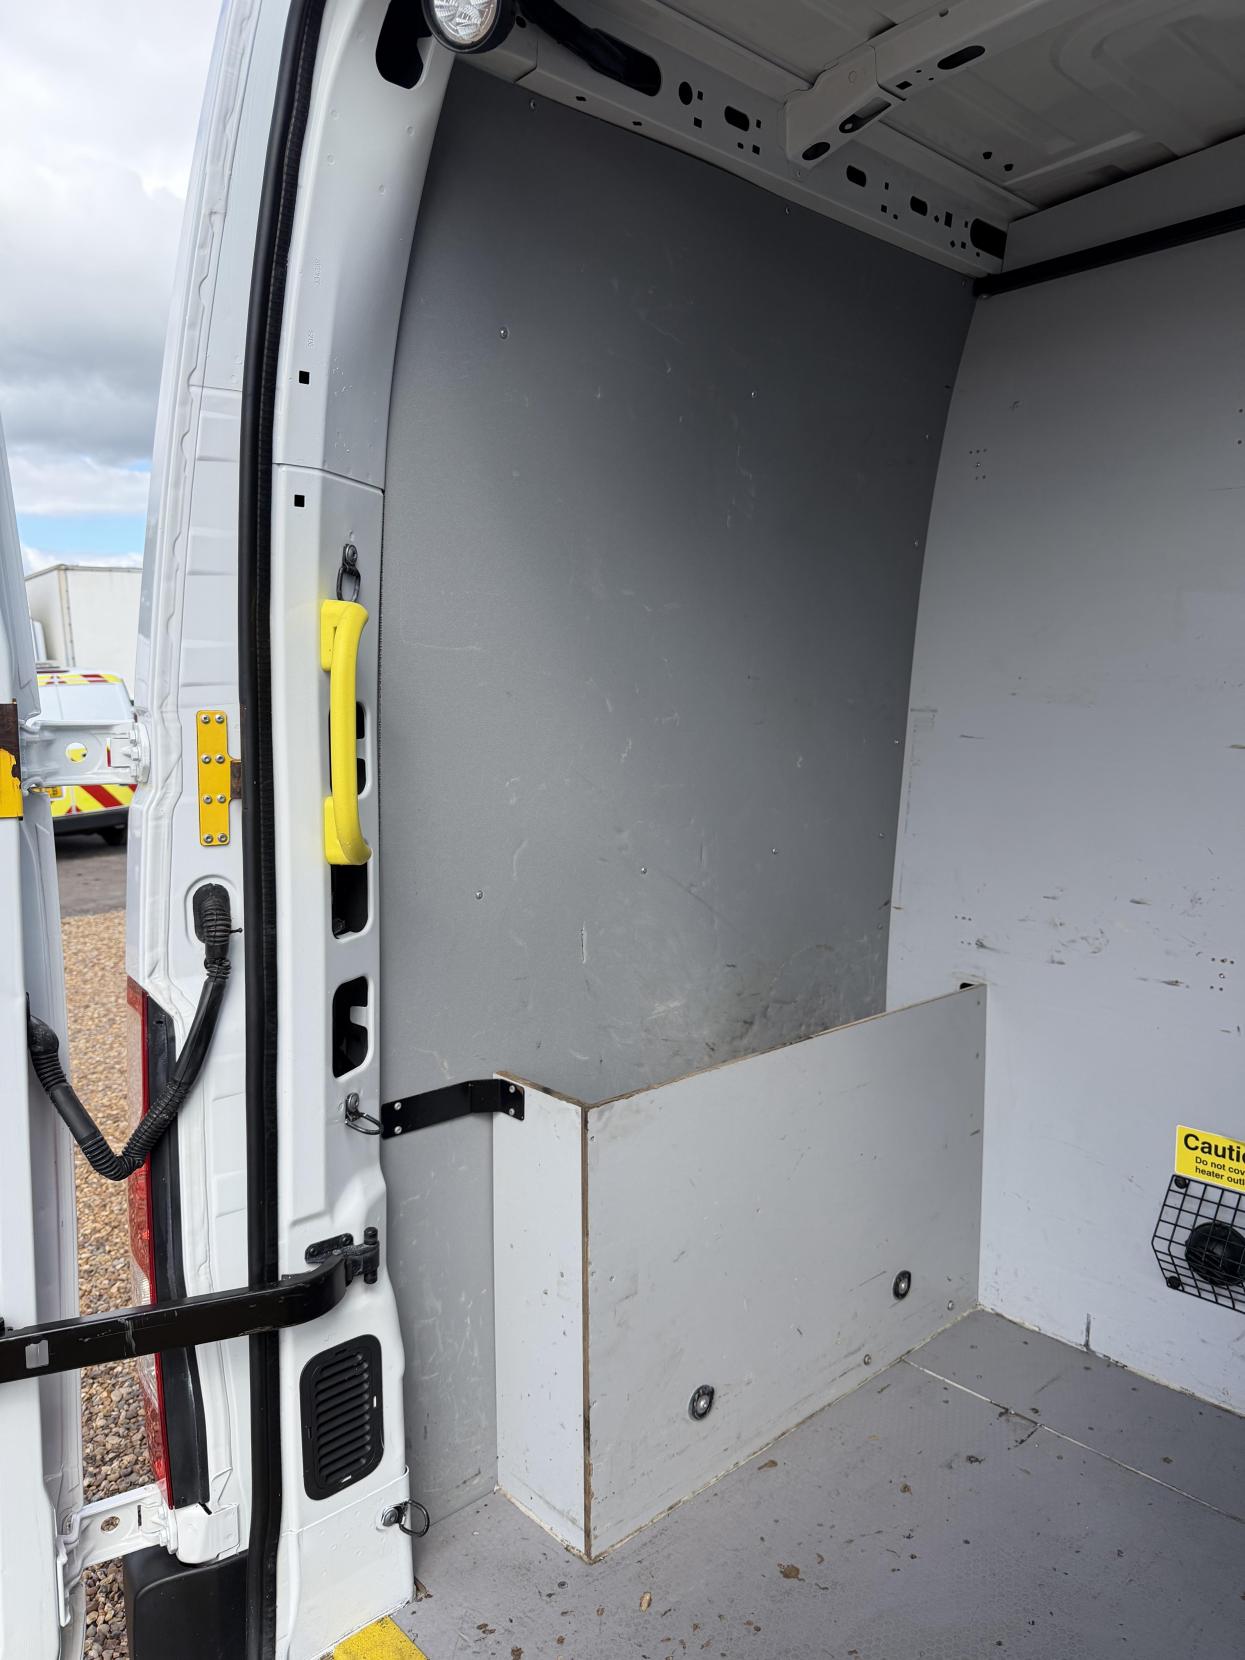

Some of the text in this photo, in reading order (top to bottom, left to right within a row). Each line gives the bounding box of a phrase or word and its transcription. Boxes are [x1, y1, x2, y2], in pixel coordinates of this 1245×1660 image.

[1195, 1156, 1208, 1166] Do
[1210, 1162, 1226, 1171] not
[1195, 1166, 1224, 1180] heater
